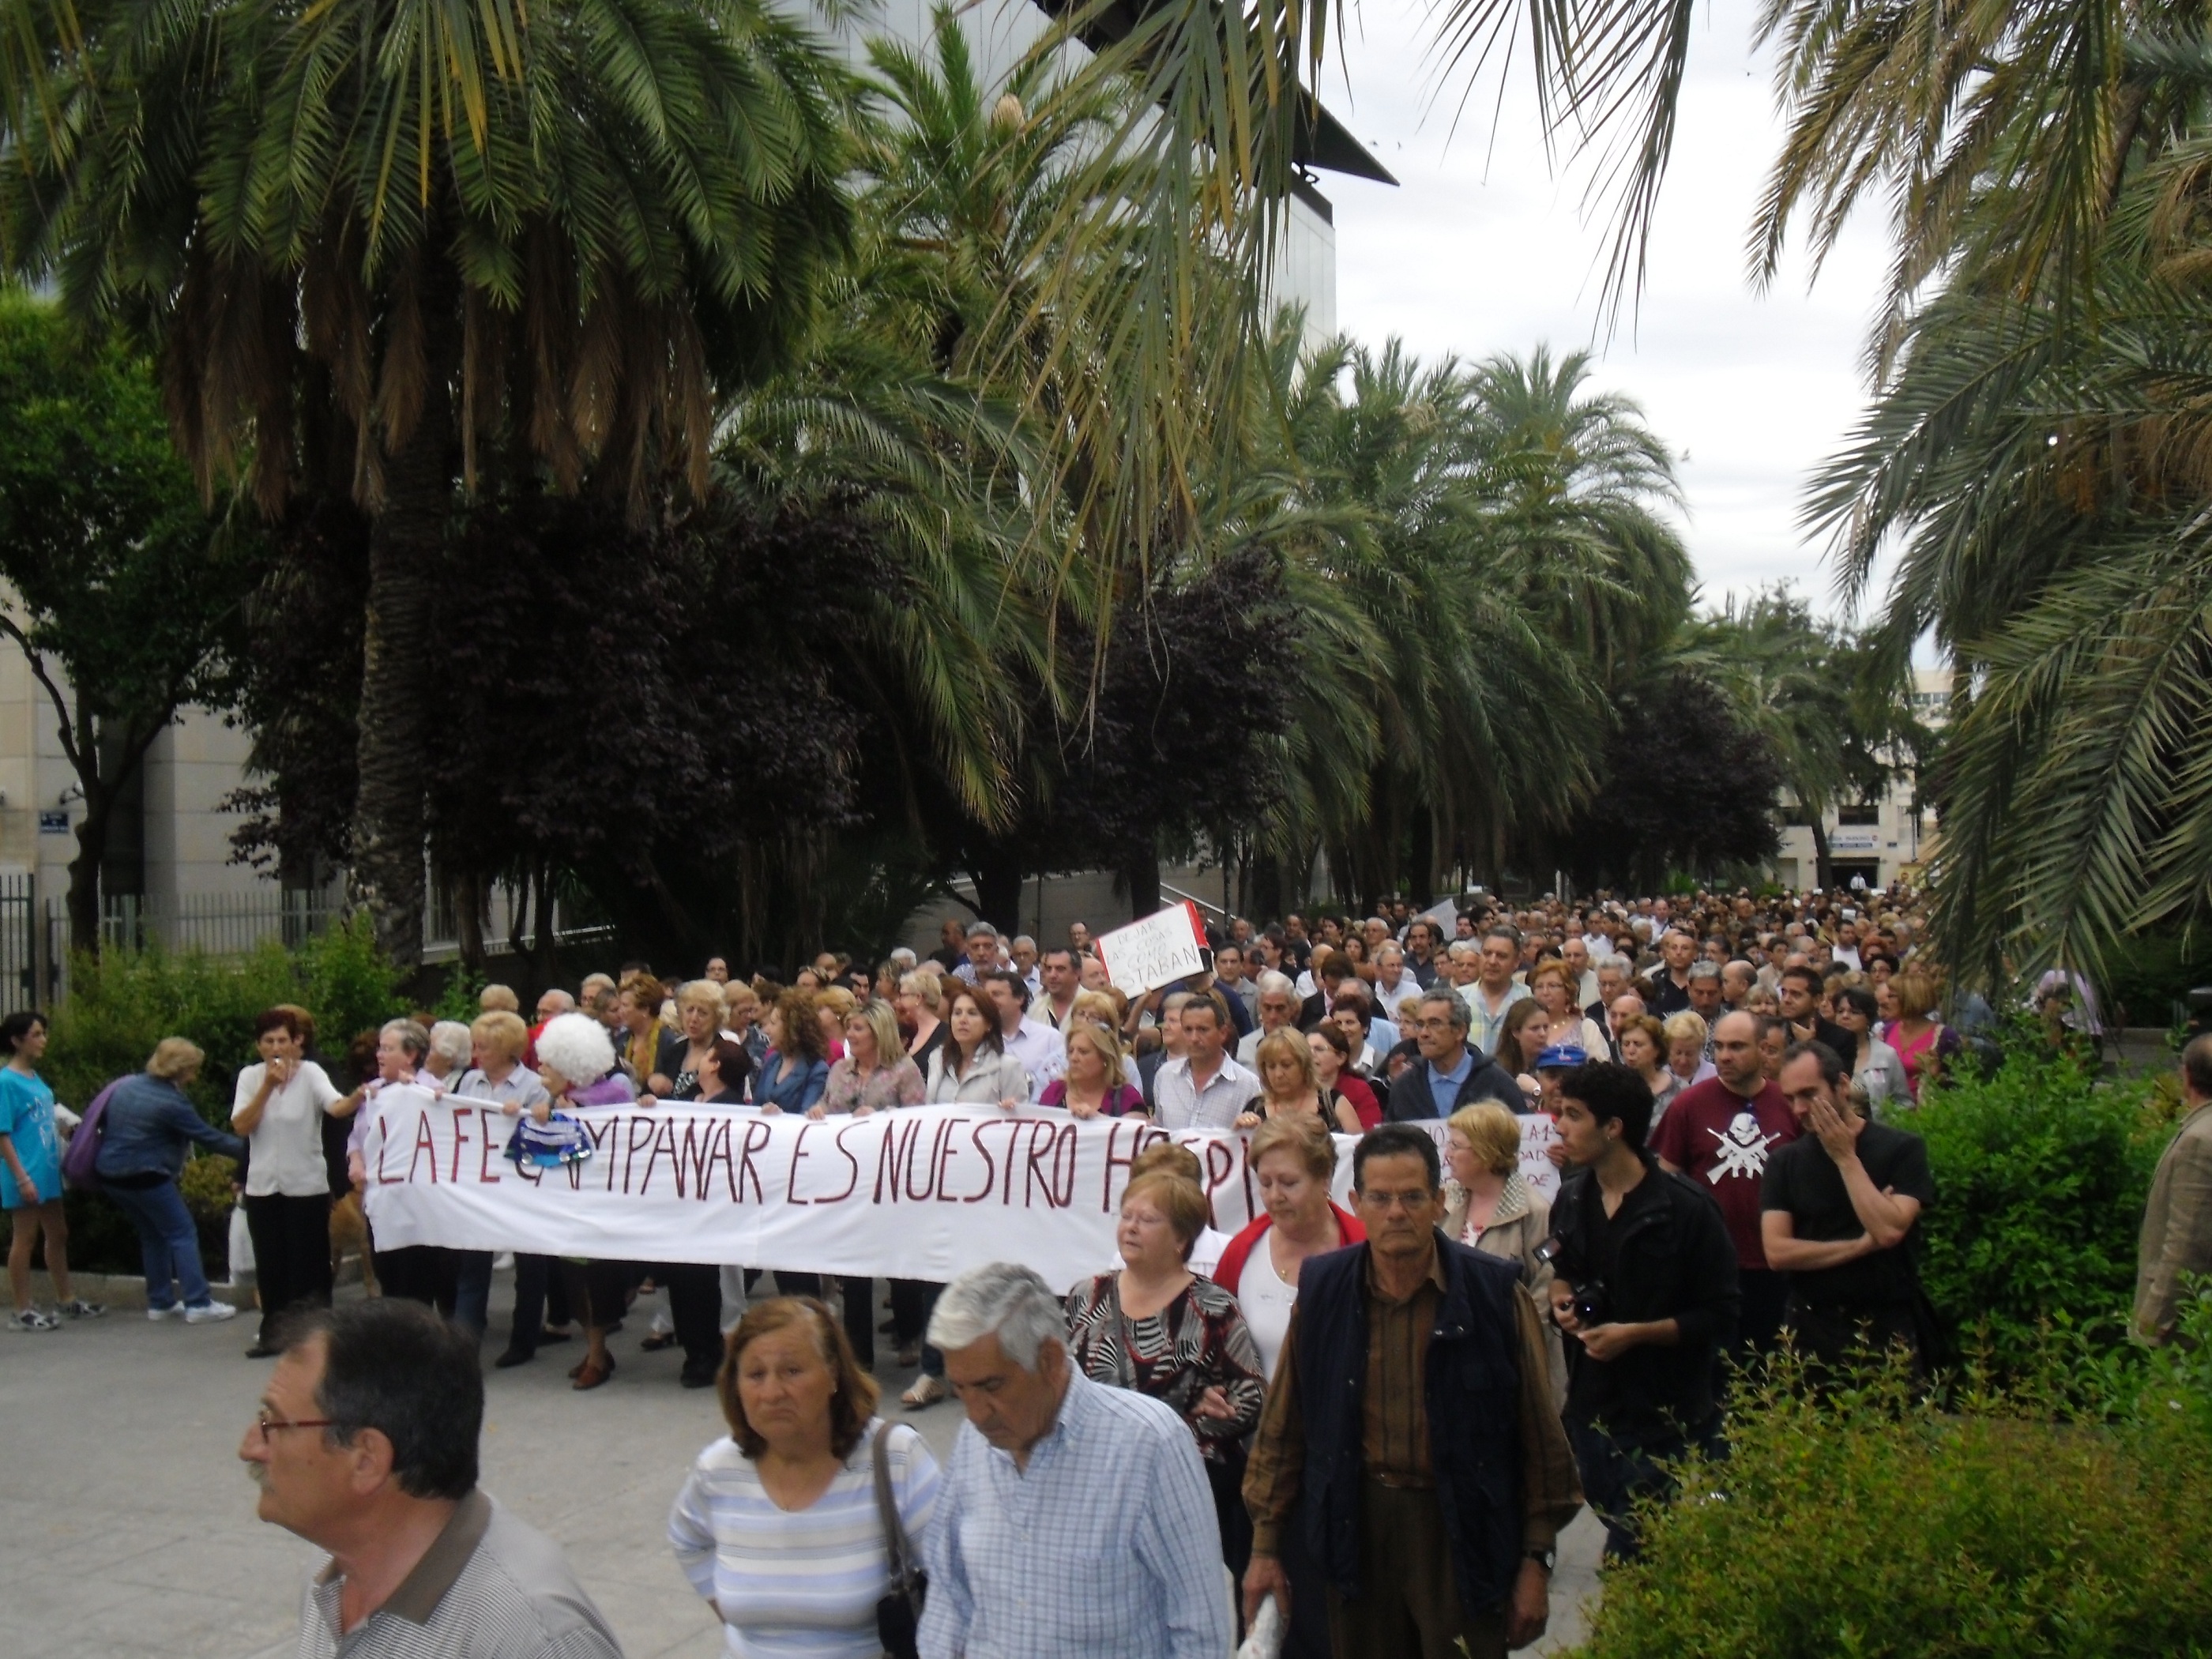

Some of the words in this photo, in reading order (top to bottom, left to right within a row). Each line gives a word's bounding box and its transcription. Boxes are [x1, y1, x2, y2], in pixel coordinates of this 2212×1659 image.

[378, 1111, 437, 1184] LA
[450, 1108, 501, 1183] FE
[787, 1120, 870, 1205] ES
[873, 1118, 1078, 1209] NUESTRO
